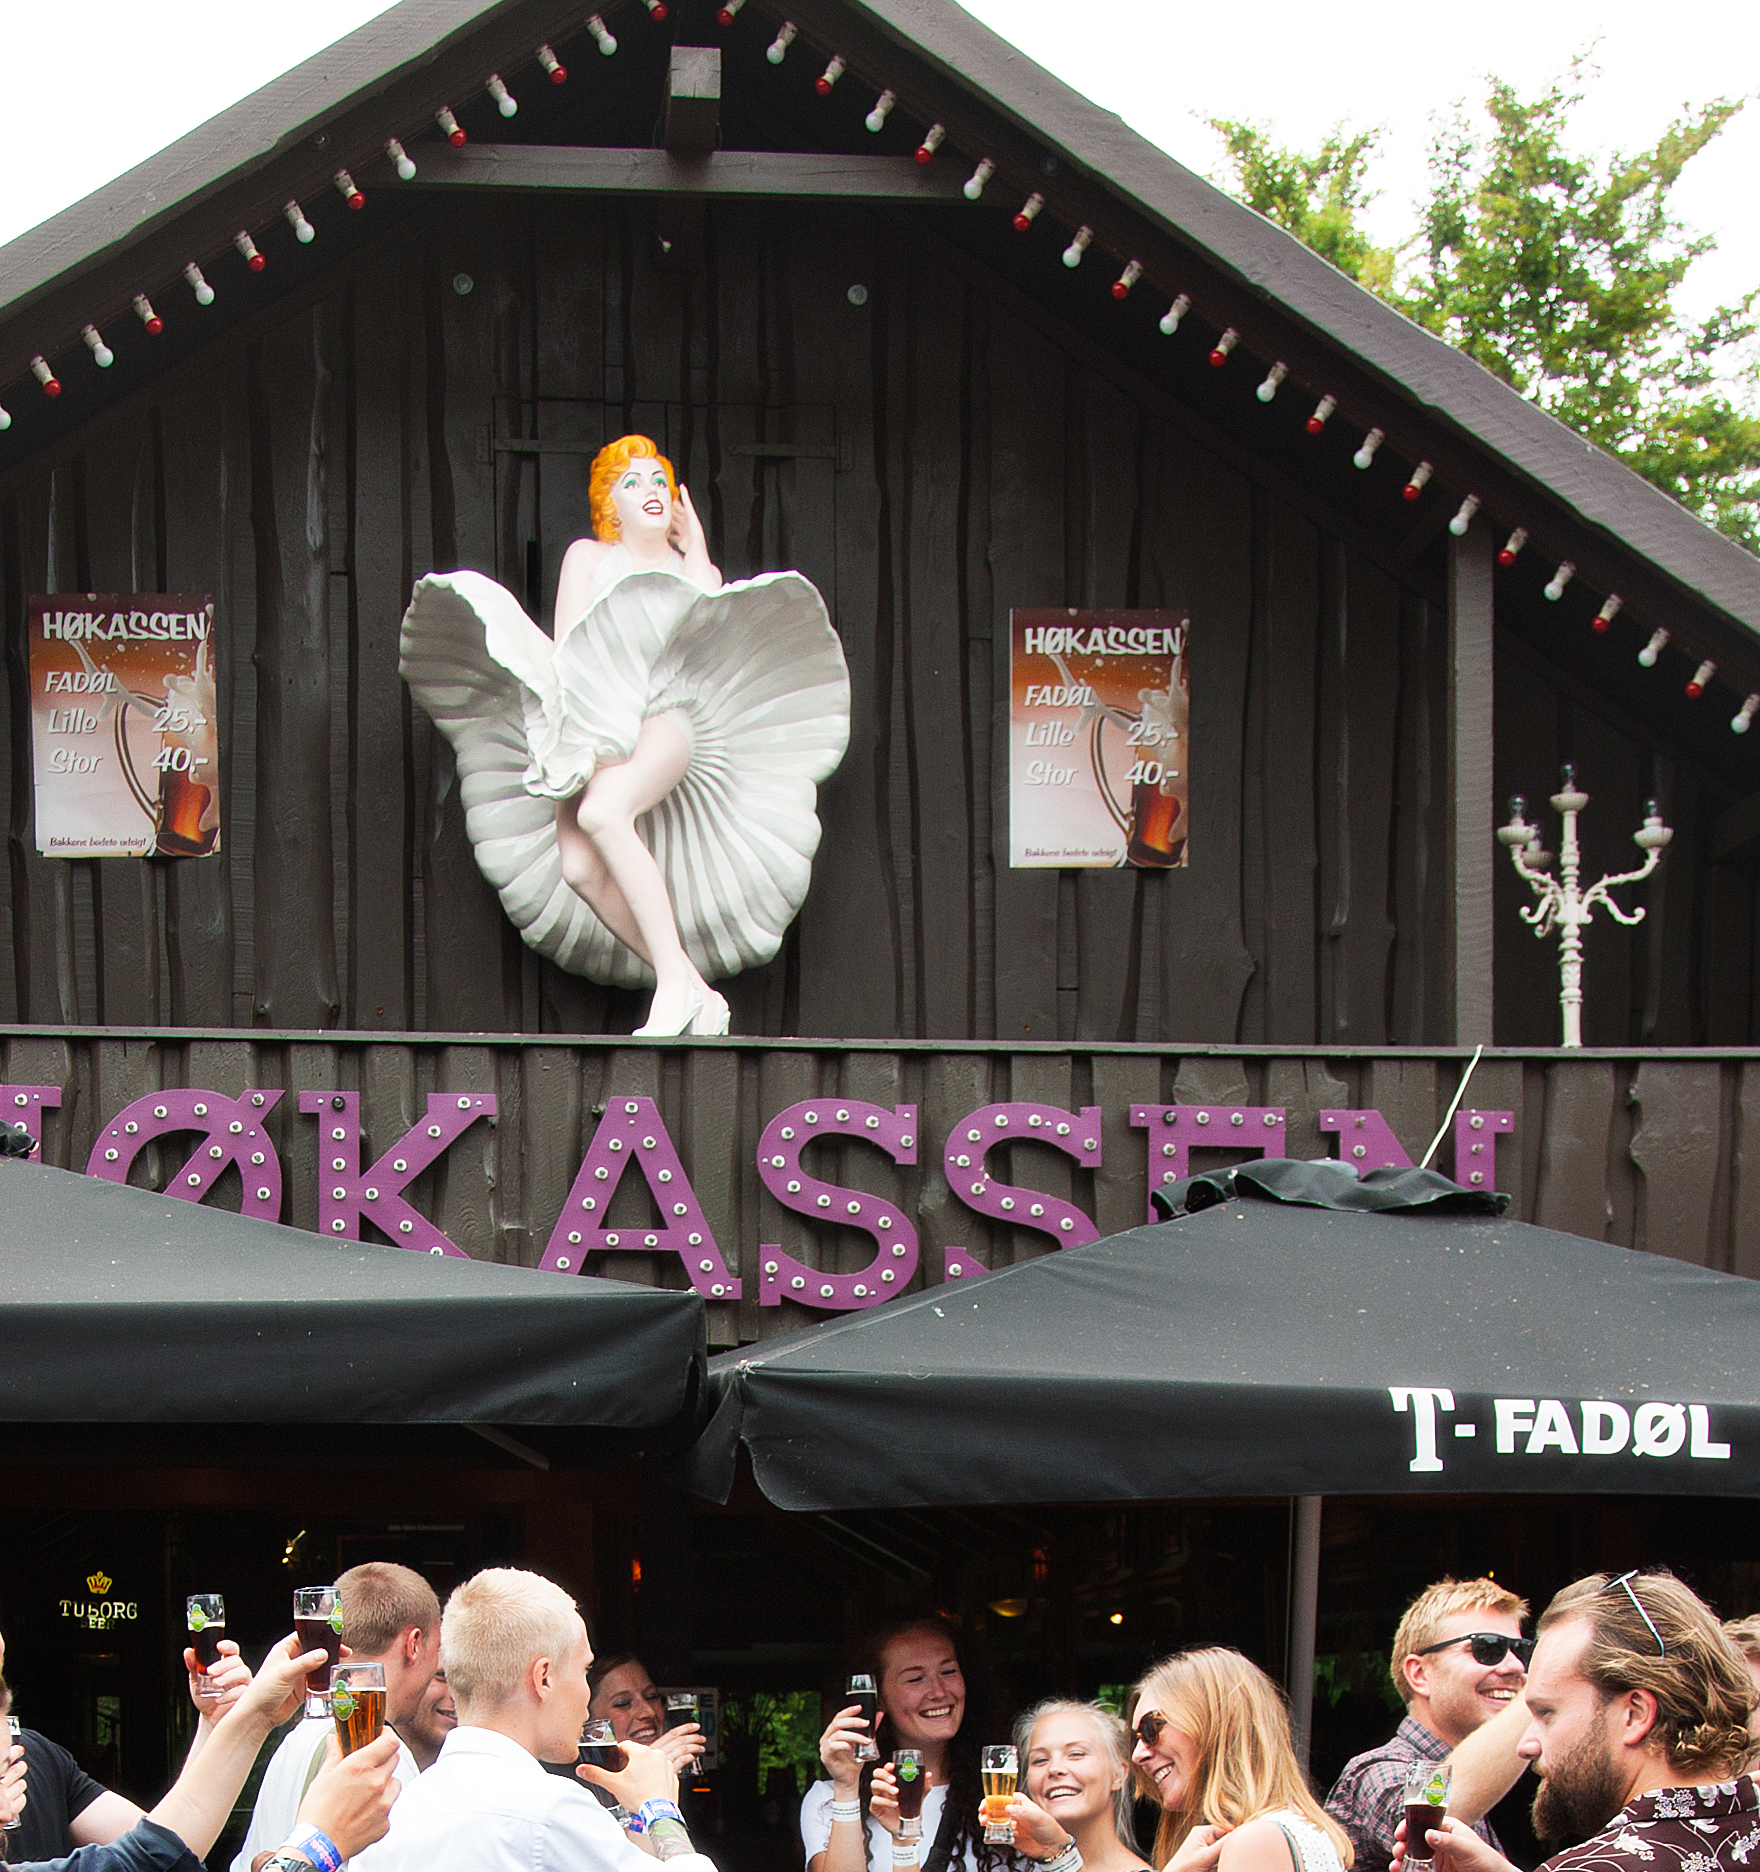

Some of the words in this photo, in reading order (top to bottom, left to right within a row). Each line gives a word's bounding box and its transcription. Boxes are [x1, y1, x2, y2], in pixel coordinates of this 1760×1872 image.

[43, 611, 206, 641] HØKASSEN
[1024, 627, 1181, 655] HØKASSEN
[45, 672, 119, 694] FADØL
[1025, 685, 1094, 706] FADØL
[47, 708, 98, 734] Lille
[152, 708, 207, 734] 25,-
[1025, 722, 1075, 747] Lille
[47, 746, 102, 774] Stor
[151, 747, 208, 774] 40,-
[1024, 761, 1078, 786] Stor
[1494, 1399, 1731, 1459] FADØL
[59, 1600, 137, 1620] TUBORG
